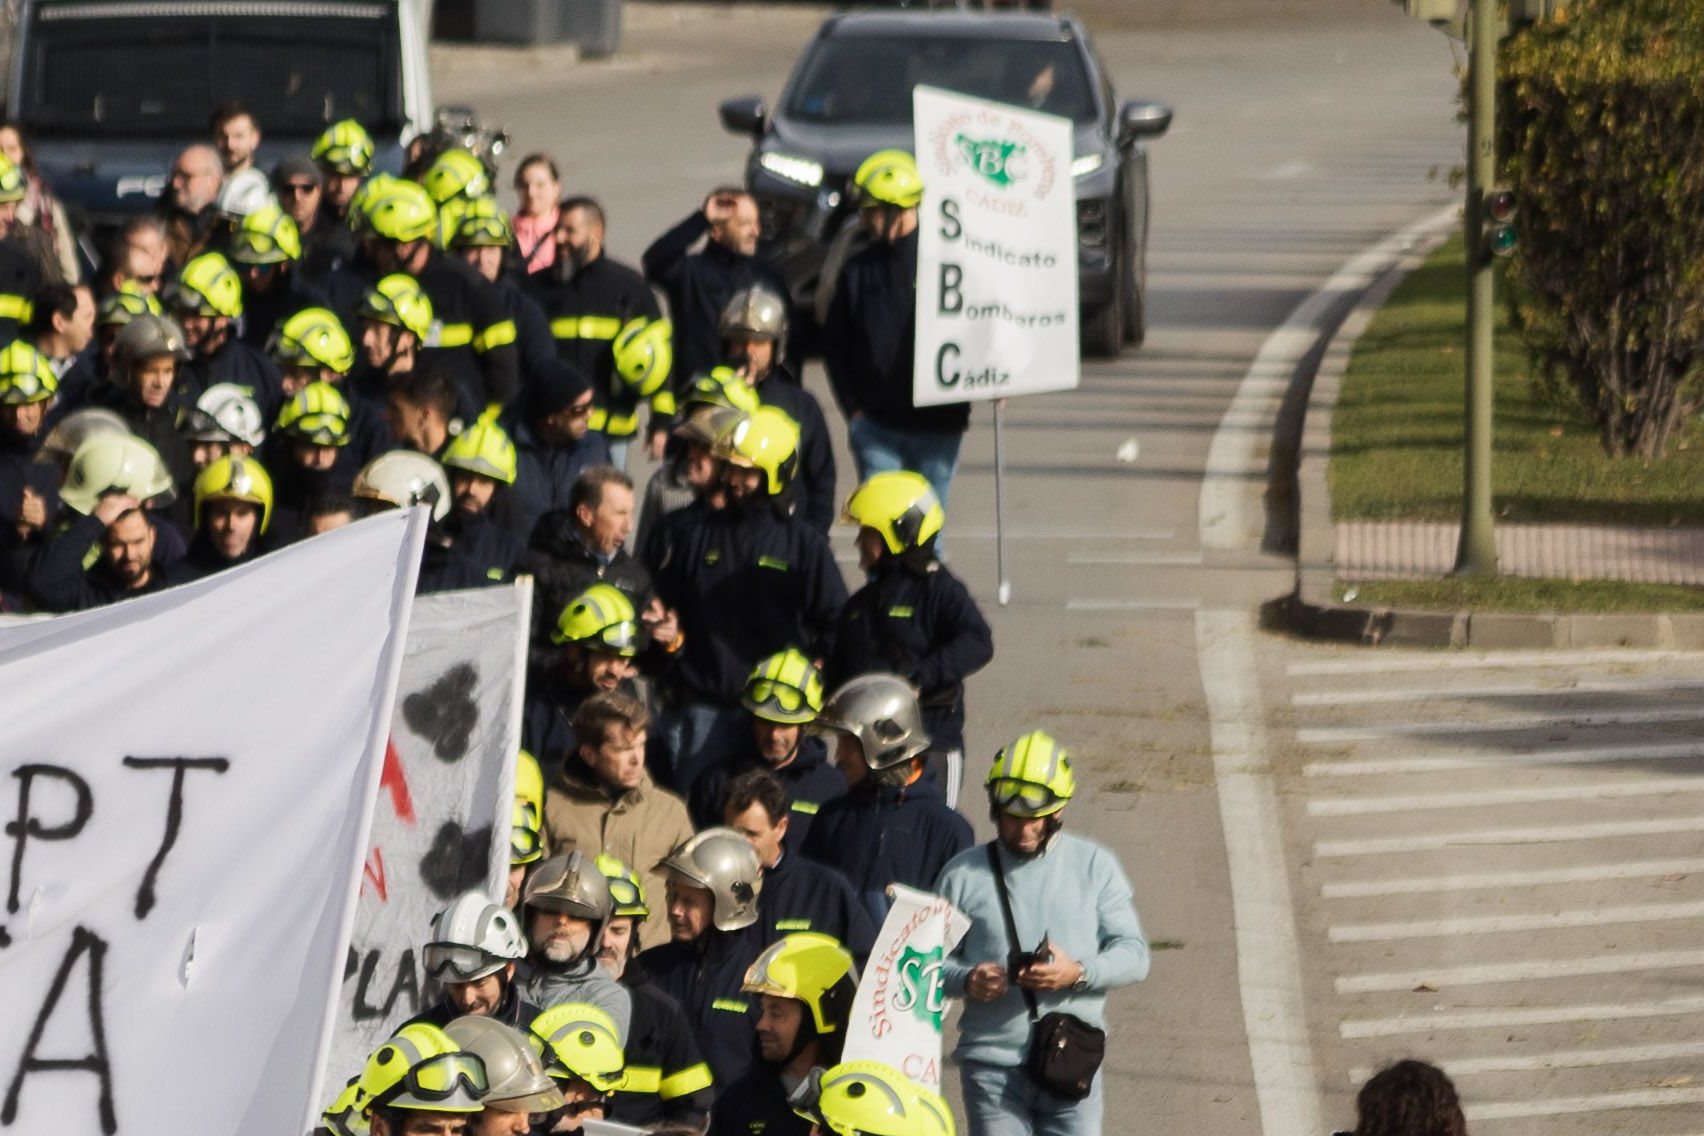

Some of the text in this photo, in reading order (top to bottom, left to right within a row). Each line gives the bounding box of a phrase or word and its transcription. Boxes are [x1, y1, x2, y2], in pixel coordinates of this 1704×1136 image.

[938, 197, 1057, 269] Sindicato
[935, 342, 1012, 391] Cádiz
[869, 905, 932, 1041] Sindicato
